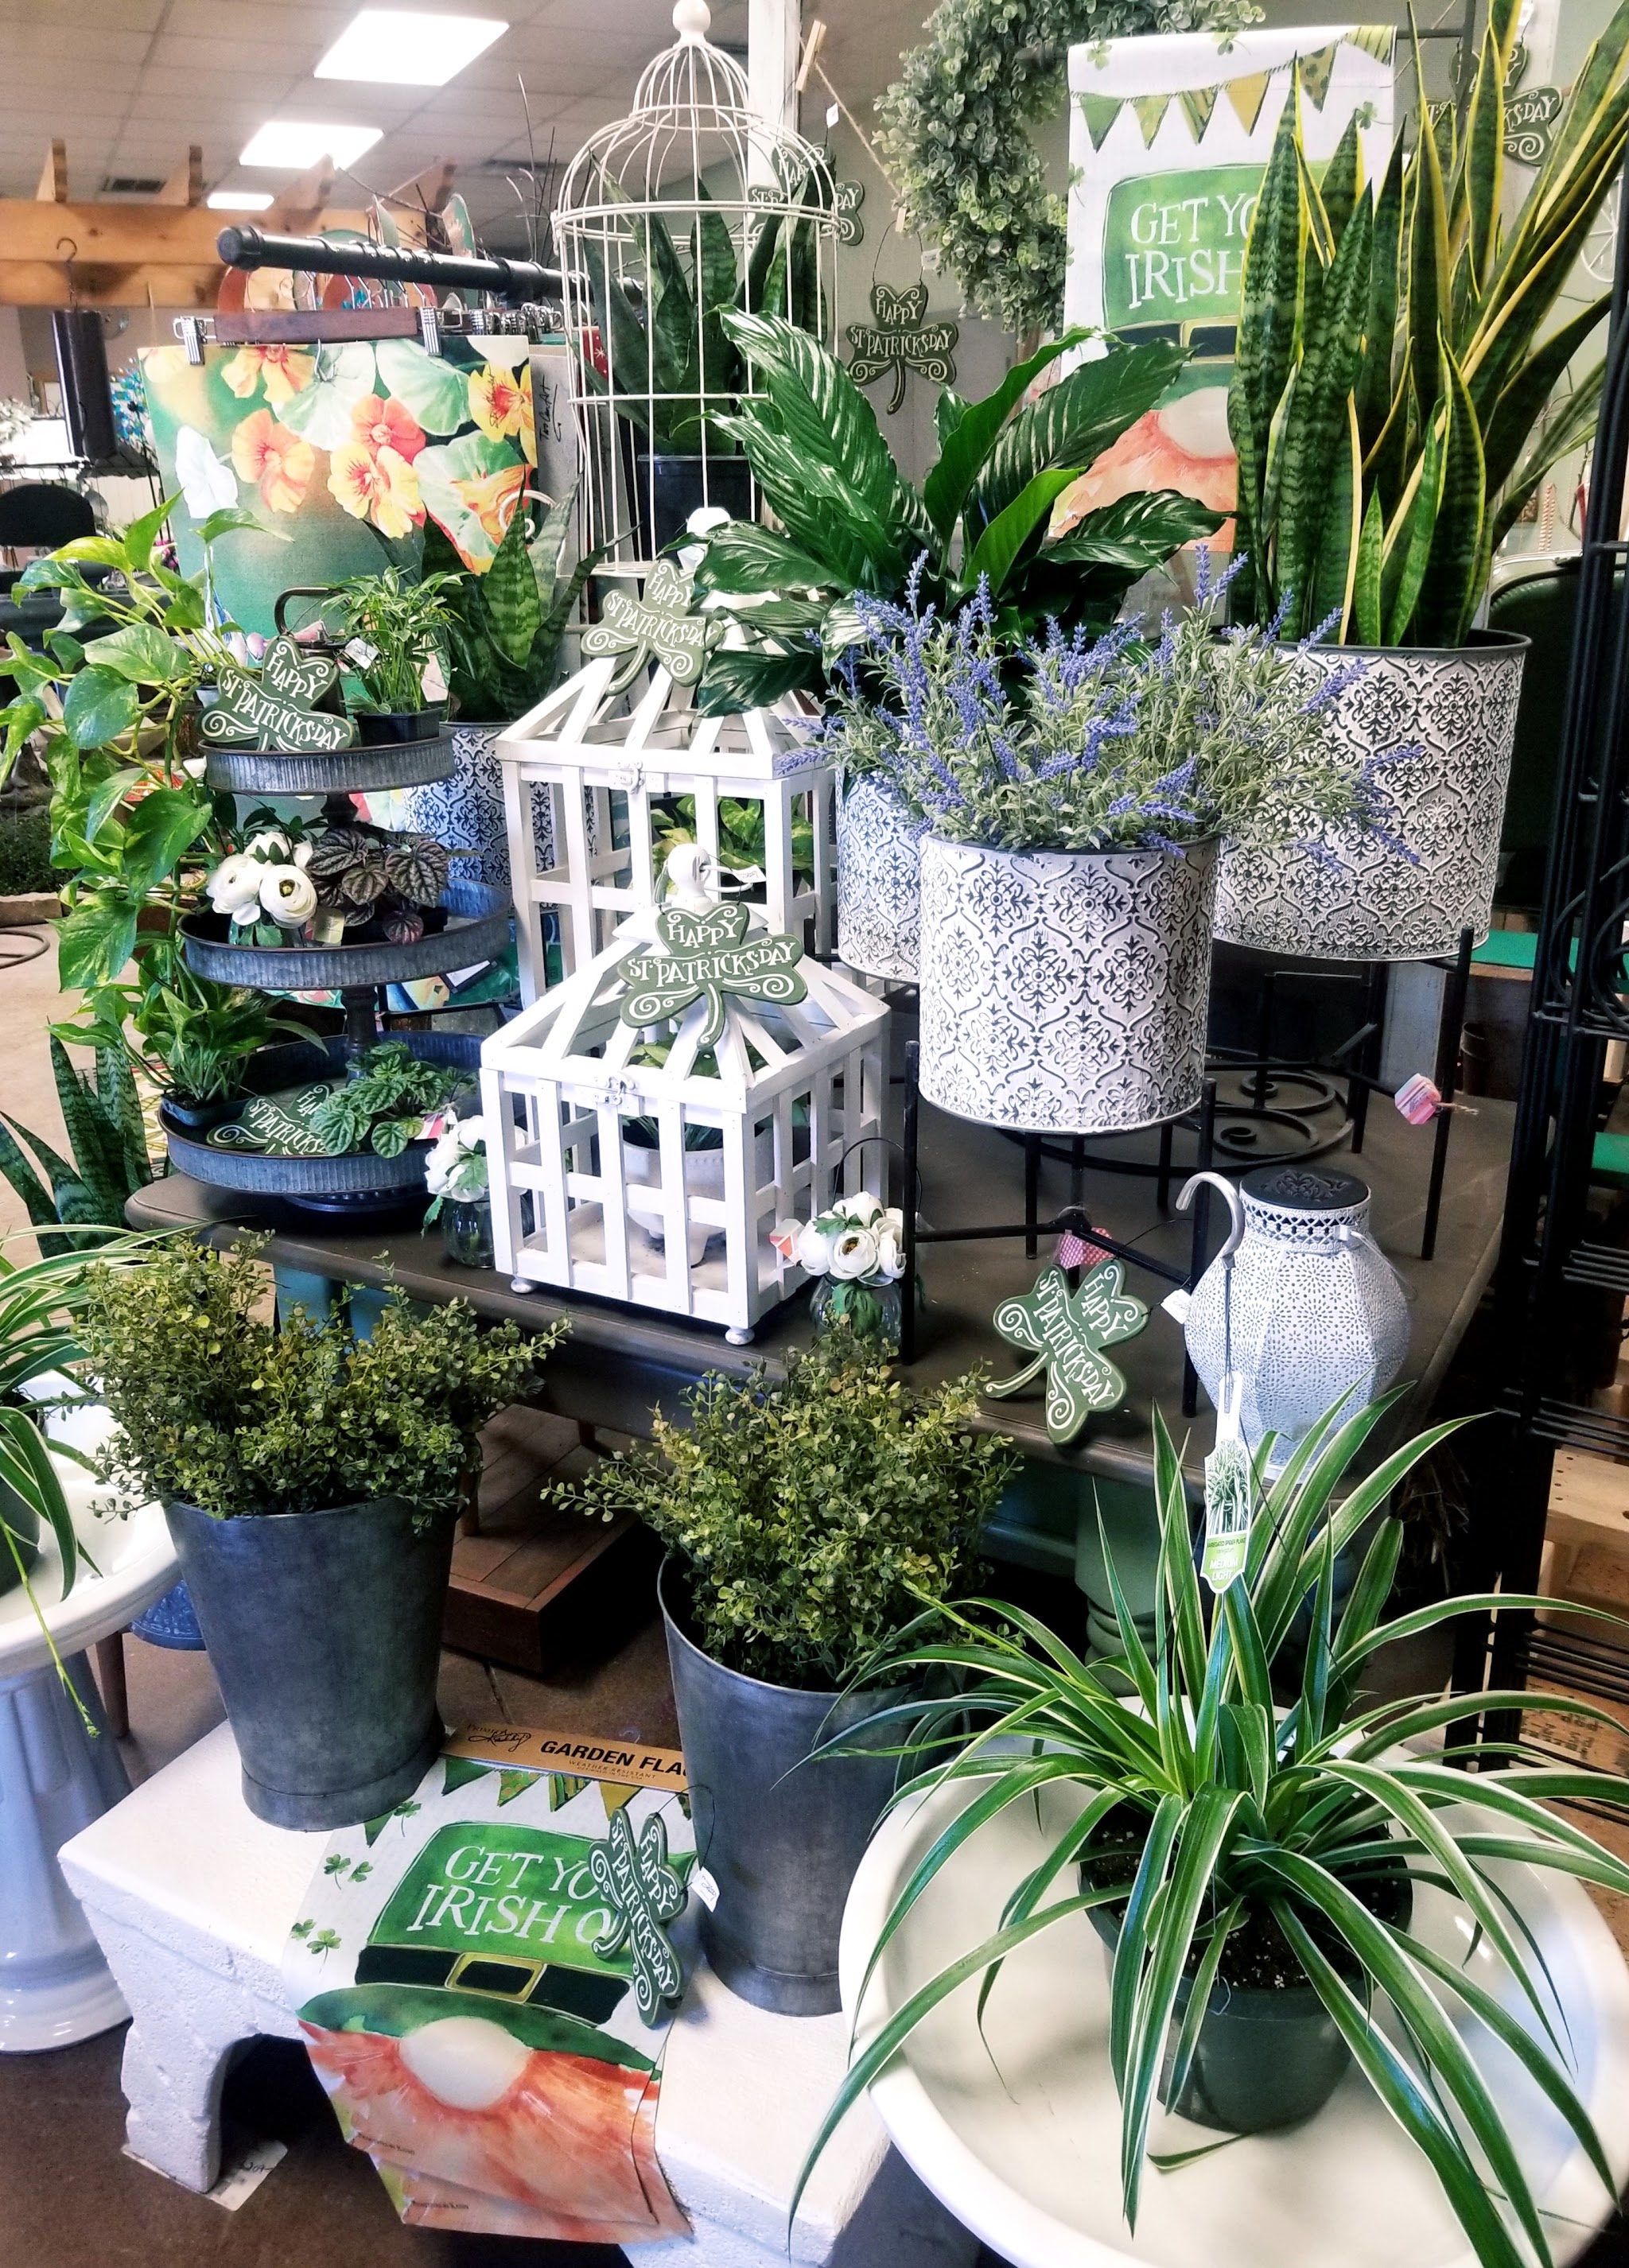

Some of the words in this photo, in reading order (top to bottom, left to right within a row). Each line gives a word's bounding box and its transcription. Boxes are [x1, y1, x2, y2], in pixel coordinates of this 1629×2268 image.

[1522, 95, 1557, 123] DAY
[1130, 197, 1209, 245] GET
[1216, 193, 1262, 239] YO
[876, 298, 923, 325] HAPPY
[929, 329, 952, 351] DAY
[647, 573, 694, 608] HAPPY
[265, 651, 328, 700] HAPPY
[315, 725, 348, 750] DAY
[667, 916, 744, 948] HAPPY
[758, 942, 796, 966] DAY
[1081, 1273, 1129, 1341] HAPPY
[1081, 1372, 1115, 1407] DAY
[1210, 1557, 1238, 1570] MEDIUM
[1211, 1570, 1234, 1581] LIGHT
[540, 1740, 636, 1766] GARDEN
[569, 1760, 608, 1770] WEATHER
[611, 1767, 656, 1779] RESISTANT
[445, 1846, 544, 1889] GET
[549, 1857, 600, 1900] YO
[640, 1831, 675, 1916] HAPPY
[406, 1884, 573, 1944] IRISH
[575, 1908, 618, 1945] O
[651, 1948, 675, 1992] DAY
